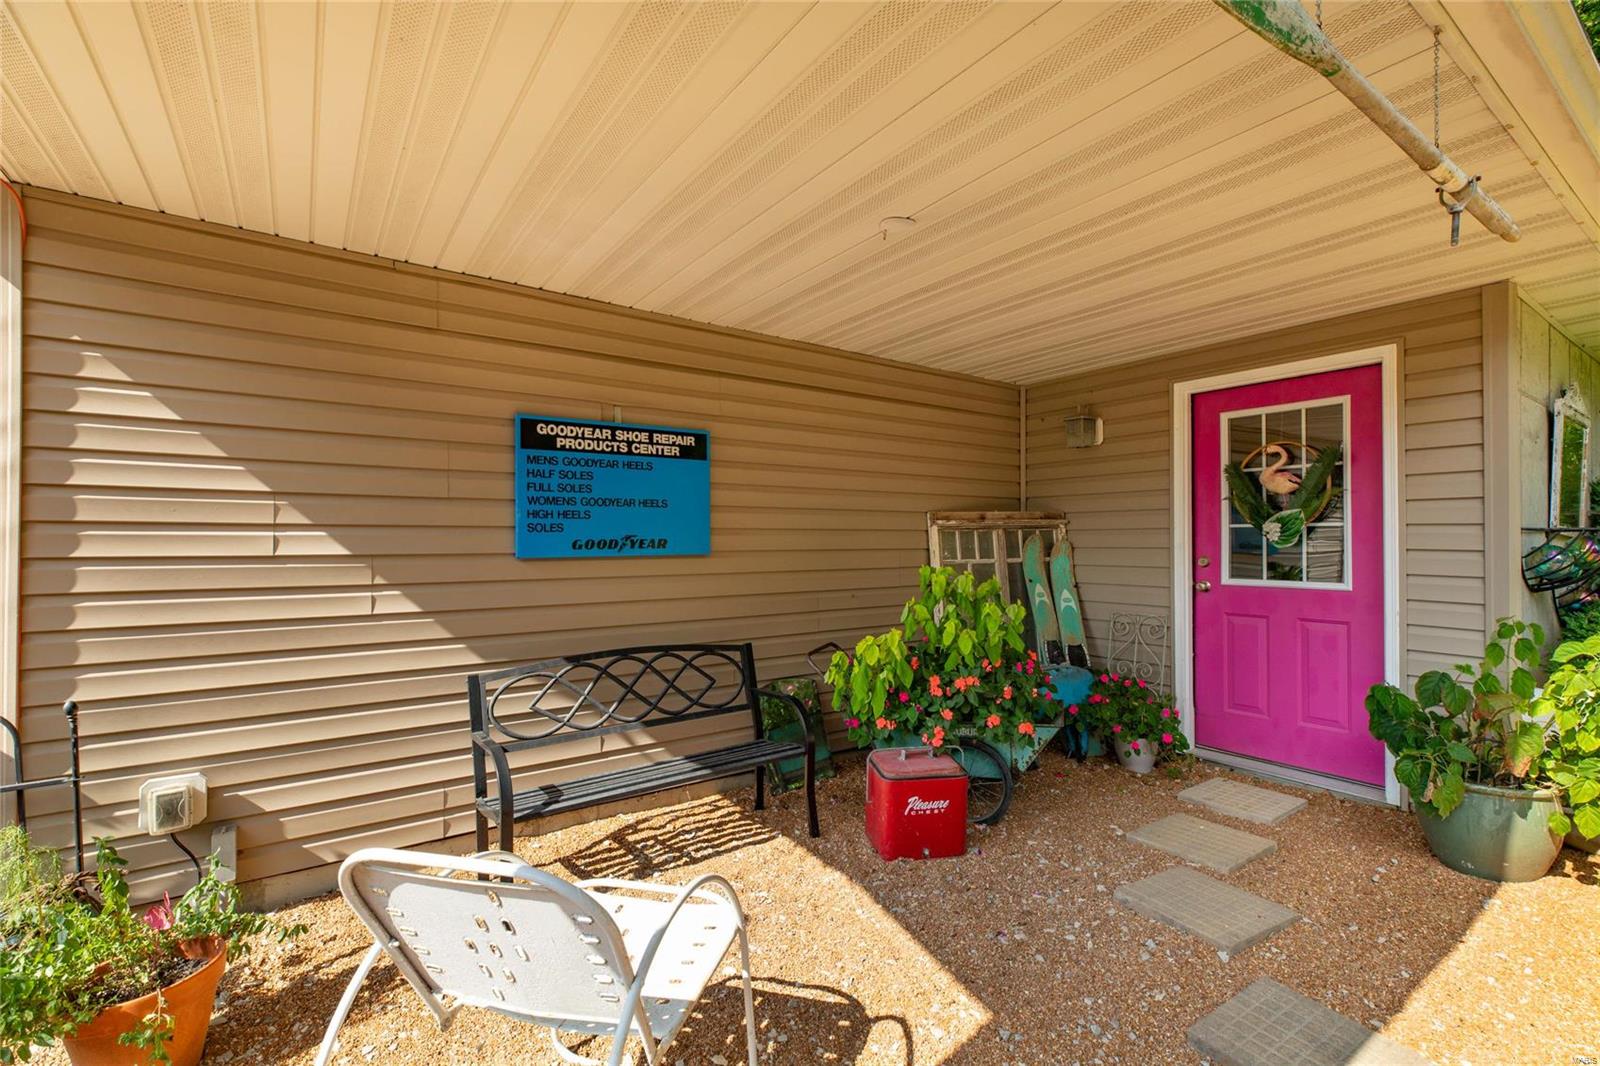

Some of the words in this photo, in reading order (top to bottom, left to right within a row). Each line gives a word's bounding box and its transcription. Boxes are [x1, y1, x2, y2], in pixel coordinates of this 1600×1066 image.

[536, 422, 612, 440] GOODYEAR
[615, 430, 649, 443] SHOE
[653, 433, 695, 446] REPAIR
[556, 437, 628, 453] PRODUCTS
[631, 443, 680, 456] CENTER
[526, 455, 559, 466] MENS
[562, 457, 620, 469] GOODYEAR
[622, 461, 654, 471] HEELS
[526, 469, 555, 479] HALF
[558, 470, 594, 480] SOLES
[526, 482, 553, 492] FULL
[557, 483, 593, 493] SOLES
[527, 496, 577, 506] WOMENS
[580, 497, 636, 508] GOODYEAR
[638, 499, 668, 508] HEELS
[527, 509, 554, 519] HIGH
[557, 510, 592, 520] HEELS
[527, 522, 564, 533] SOLES
[571, 536, 668, 552] GOODYEAR
[904, 796, 950, 816] Pleasure
[911, 808, 945, 816] CHEST
